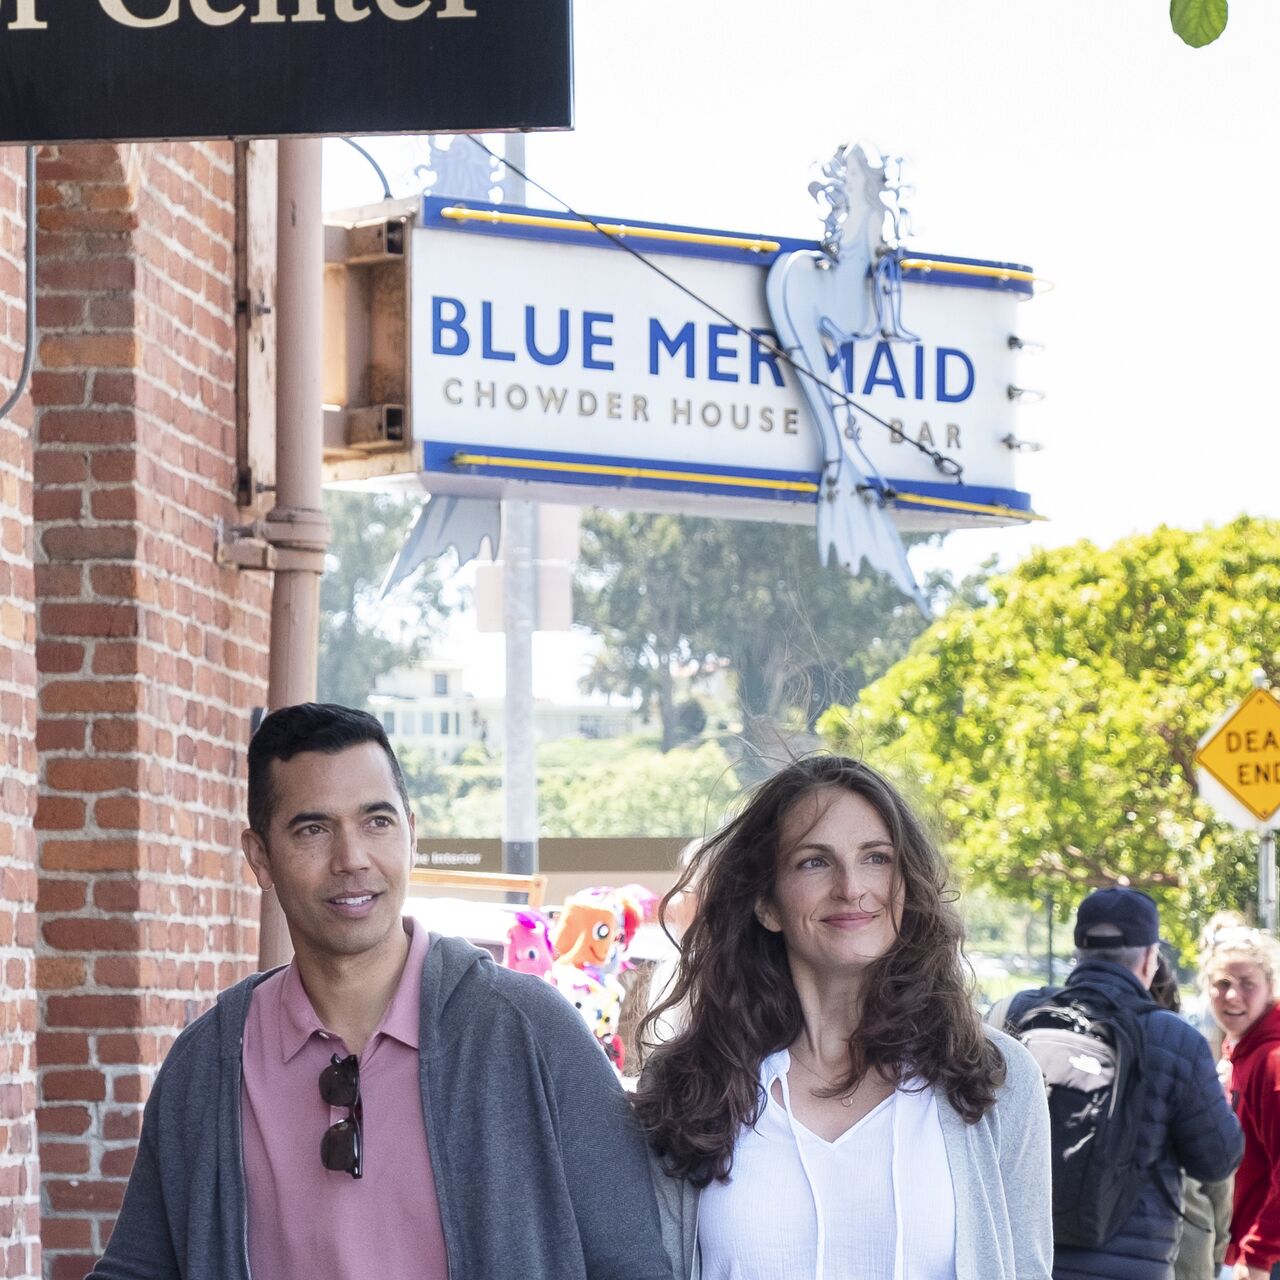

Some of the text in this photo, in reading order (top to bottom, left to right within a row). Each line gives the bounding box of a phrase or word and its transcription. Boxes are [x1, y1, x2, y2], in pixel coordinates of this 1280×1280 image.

[432, 295, 976, 404] BLUE MERMAID
[443, 378, 961, 449] CHOWDER HOUSE & BAR
